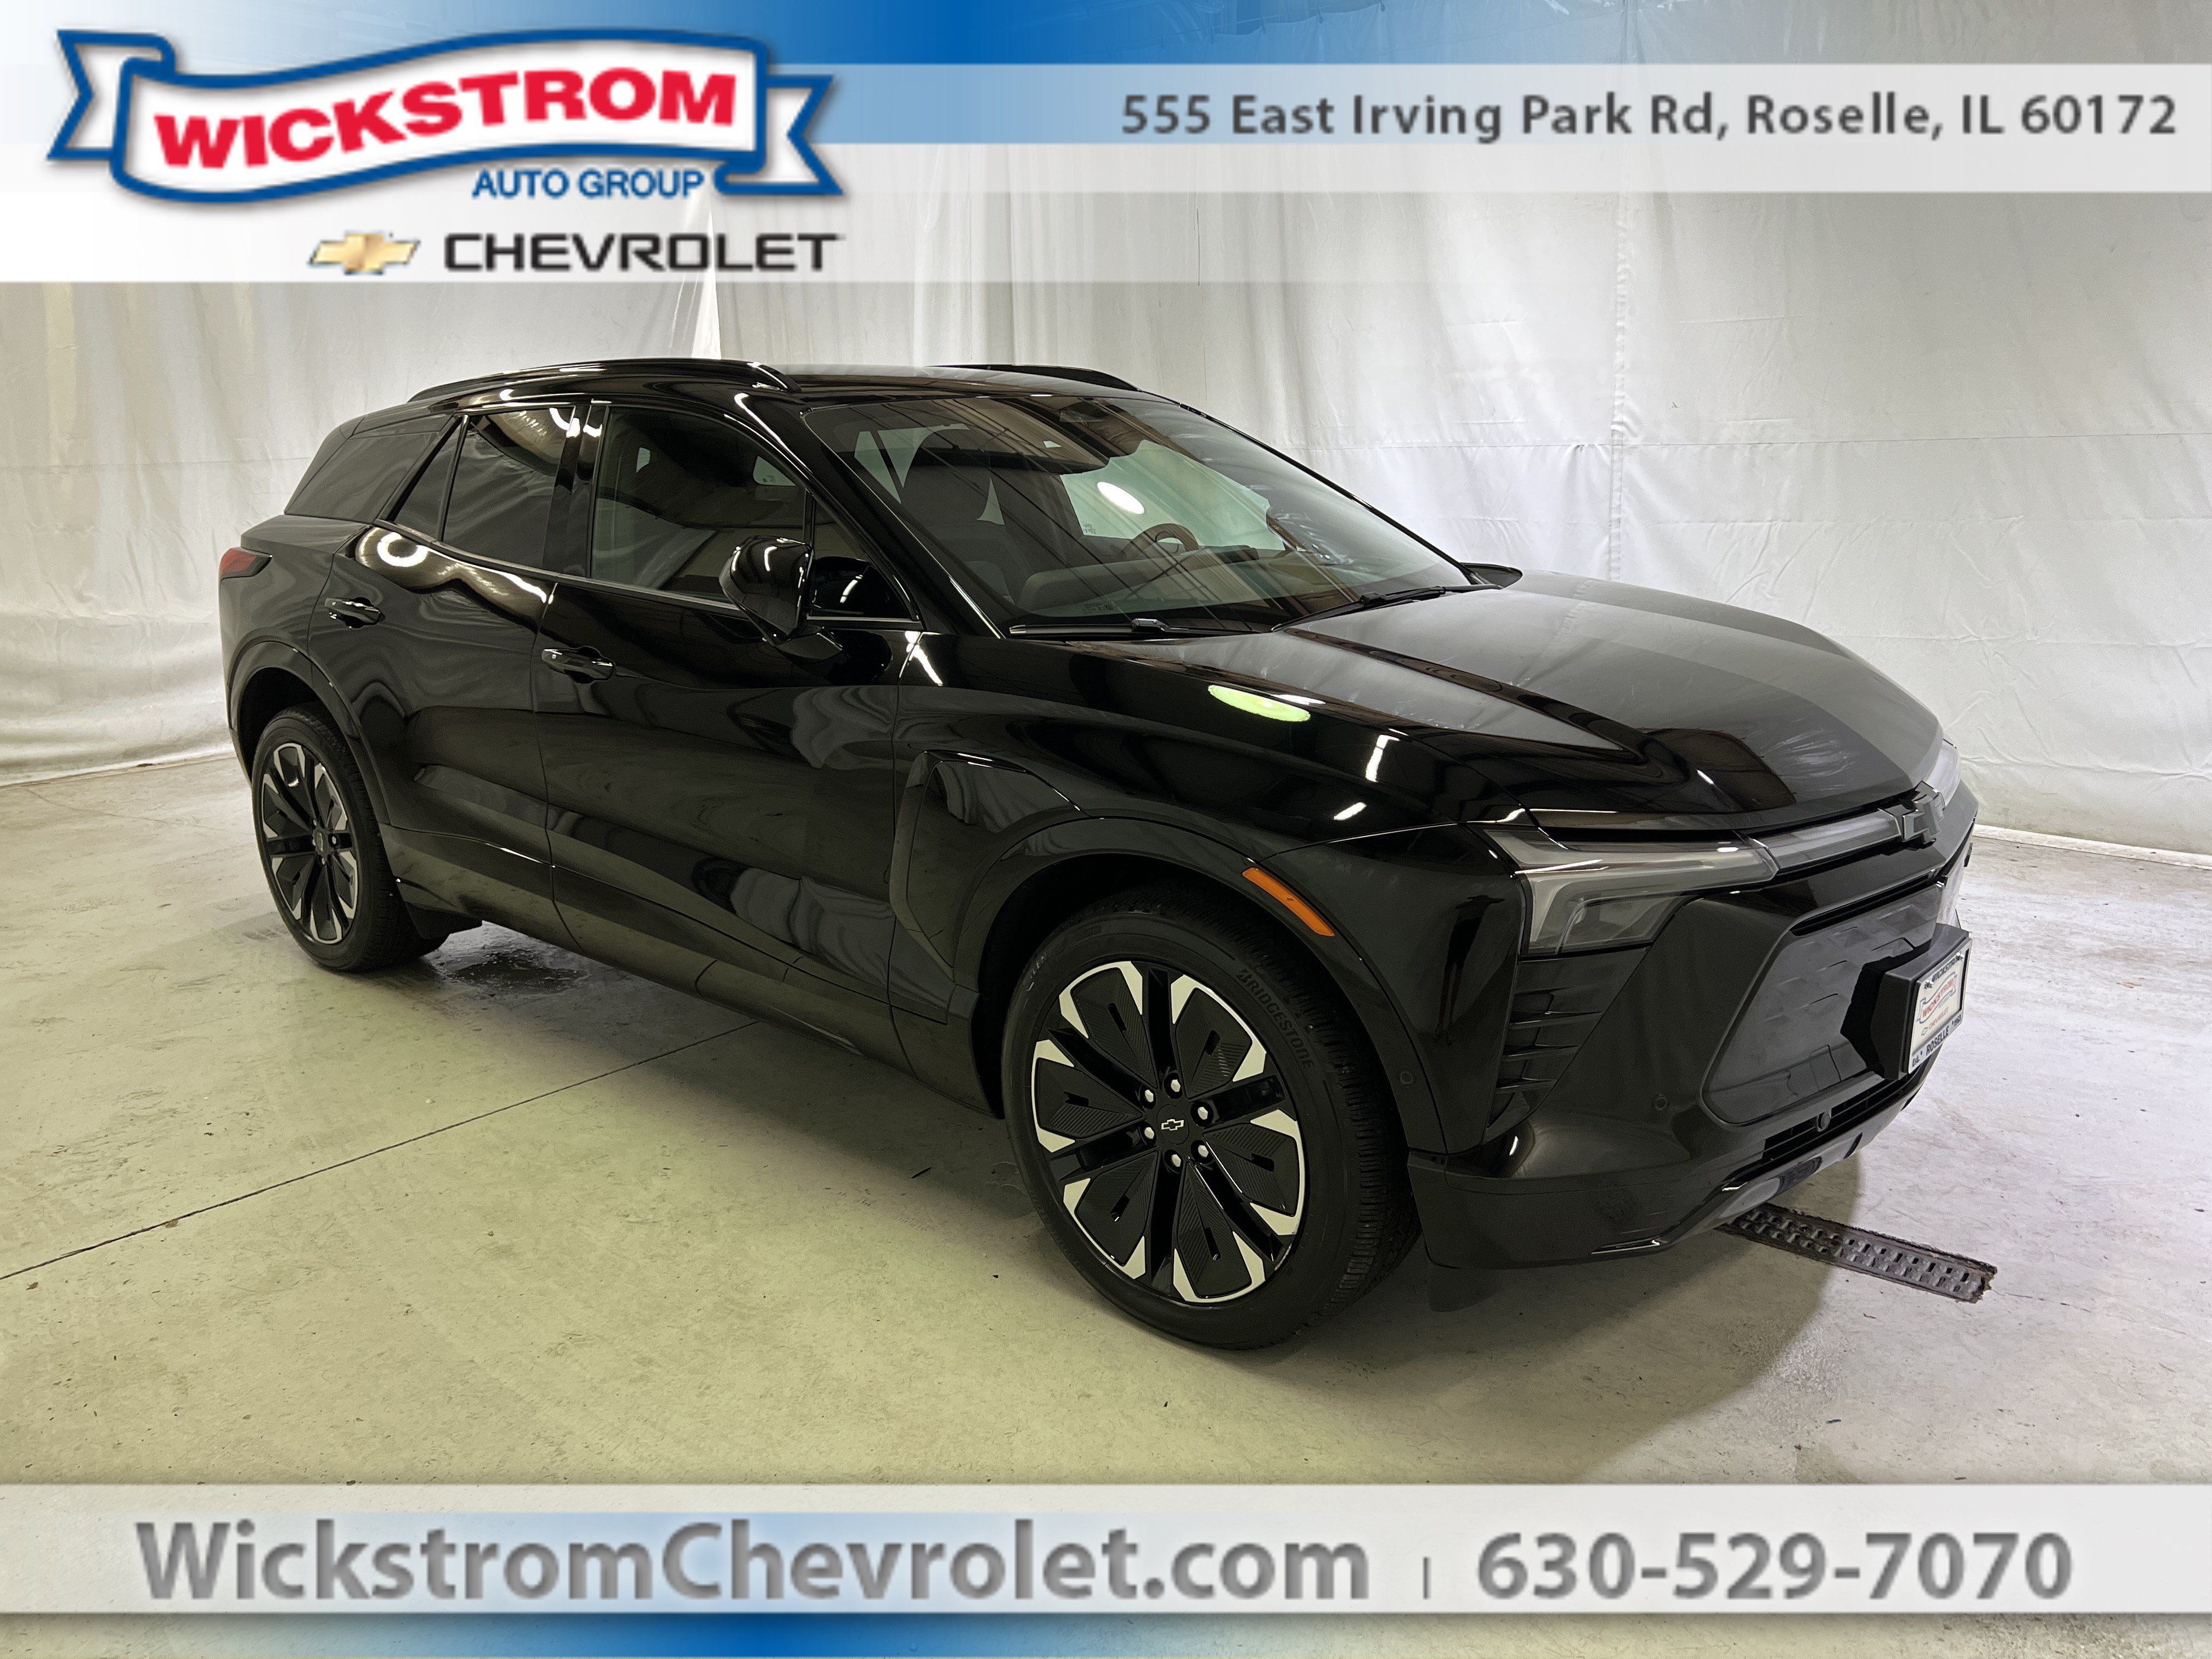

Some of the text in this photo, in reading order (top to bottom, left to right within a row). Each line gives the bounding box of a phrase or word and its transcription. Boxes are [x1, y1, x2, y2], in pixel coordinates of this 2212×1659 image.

[1922, 978, 1954, 1018] WICKSTROM
[1235, 968, 1318, 1073] BRIDGESTONE
[1928, 1006, 1949, 1030] CHEVROLET
[1926, 1025, 1950, 1056] ROSELLE
